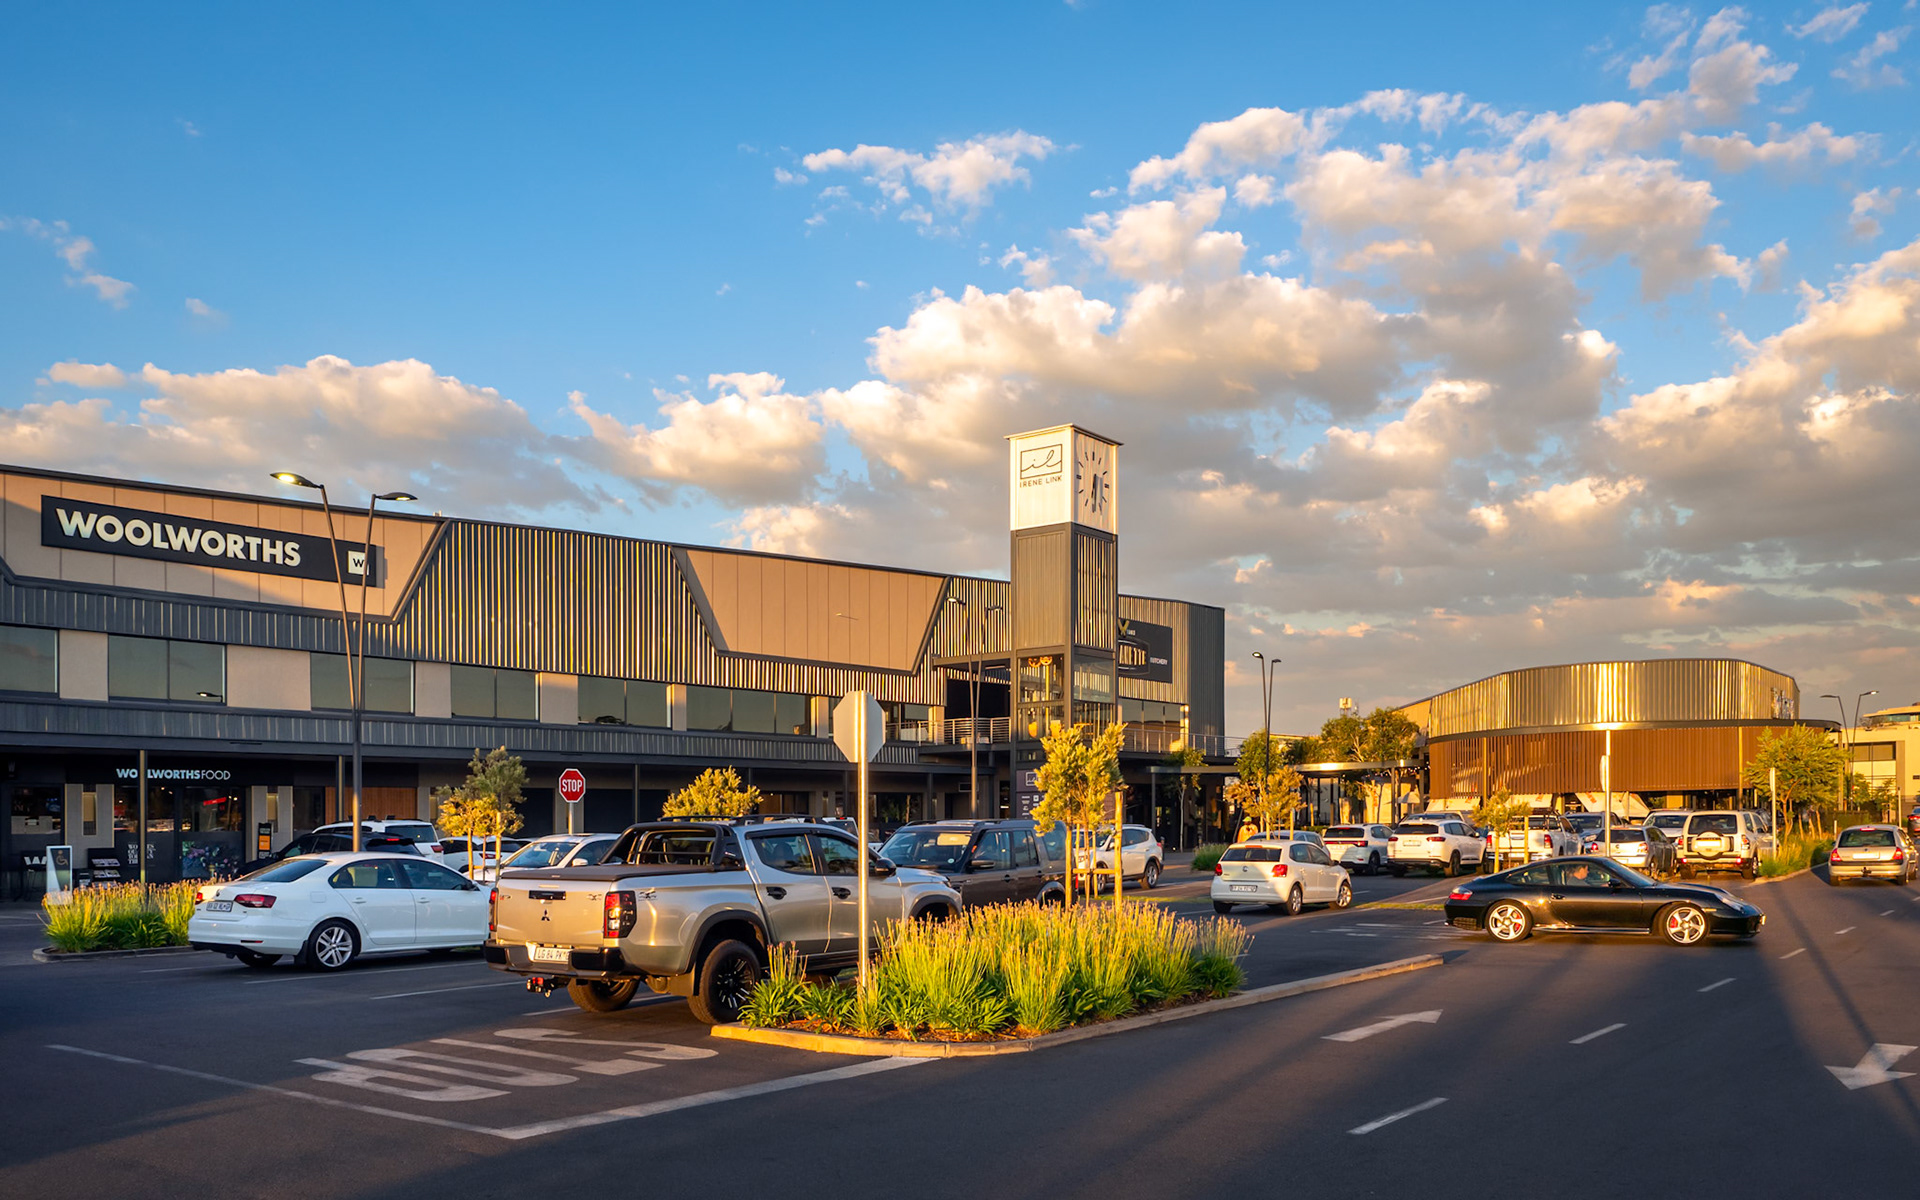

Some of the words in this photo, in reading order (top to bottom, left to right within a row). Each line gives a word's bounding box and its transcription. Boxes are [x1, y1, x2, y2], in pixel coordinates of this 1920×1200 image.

[1019, 478, 1042, 489] IRENE
[1045, 474, 1062, 485] LINK
[56, 507, 301, 567] WOOLWORTHS
[353, 557, 364, 568] W
[116, 768, 231, 780] WOLWORTHSFOOD
[562, 779, 583, 792] STOP
